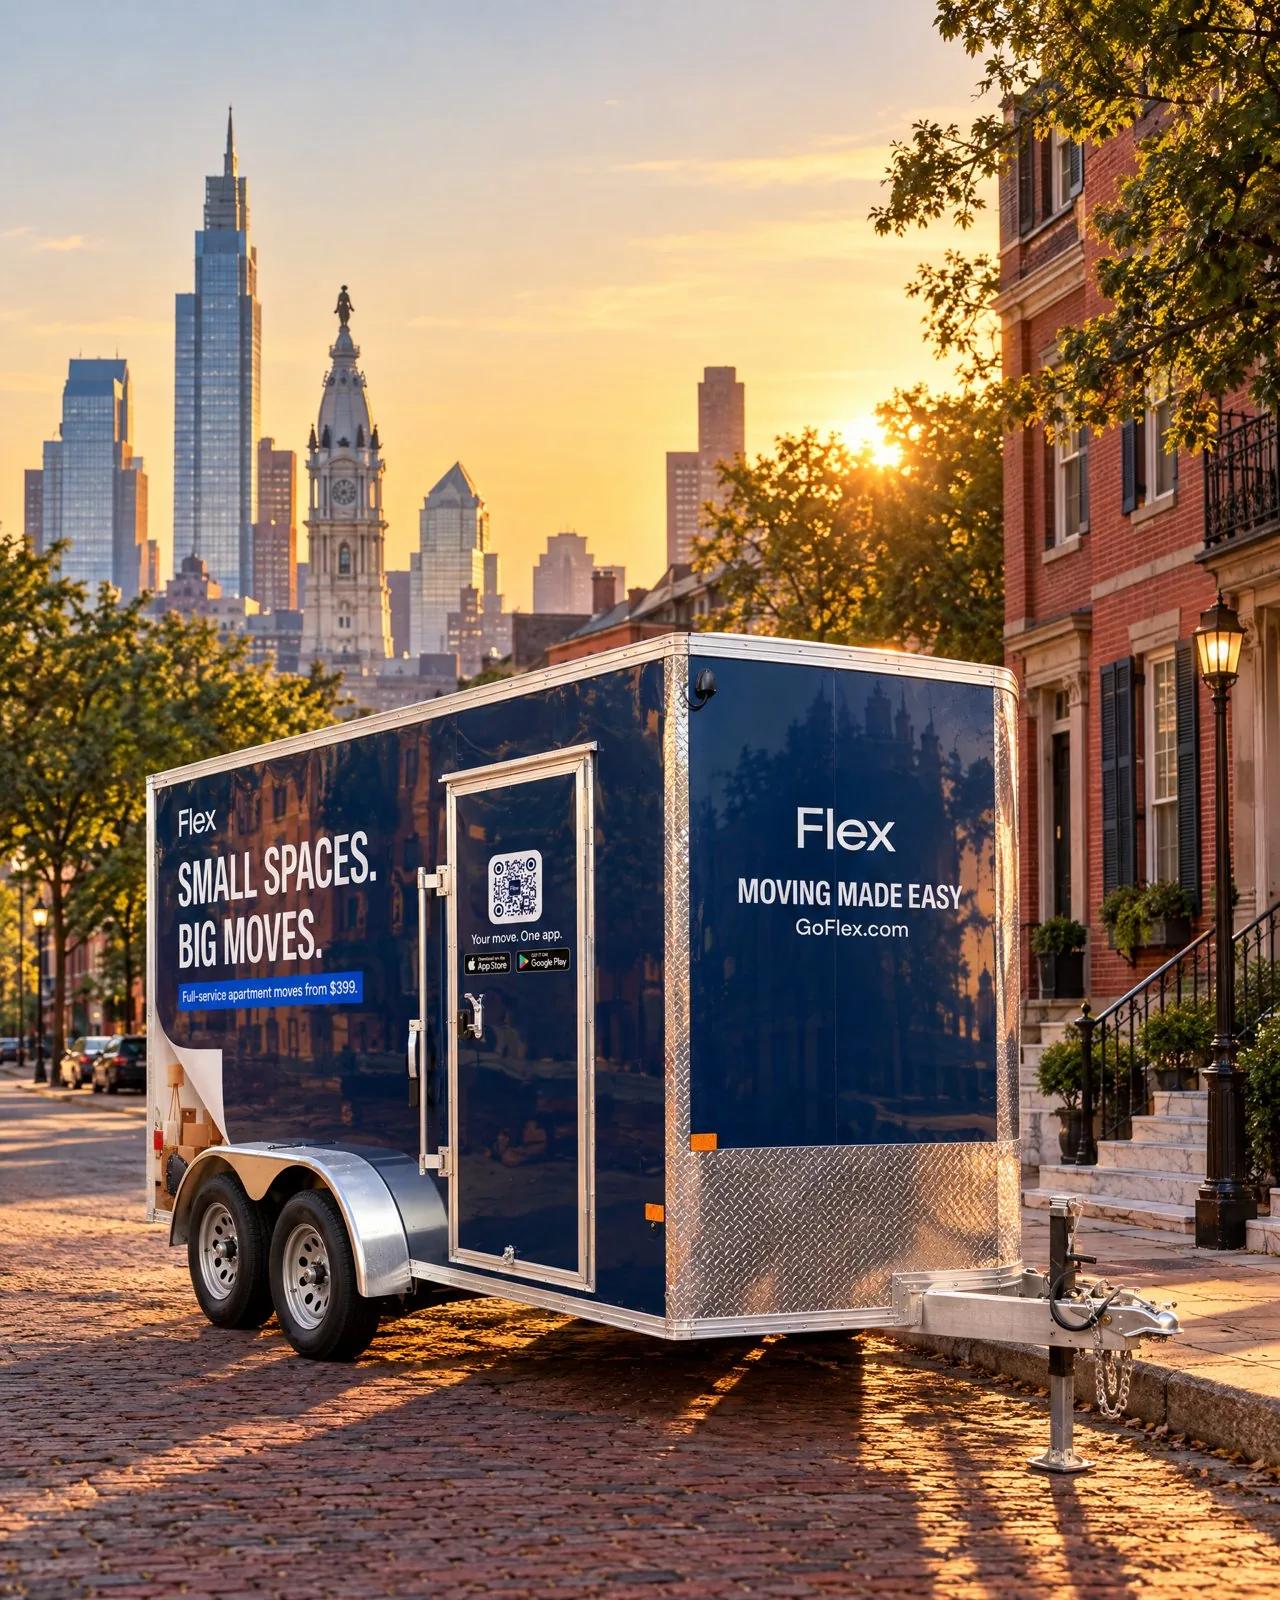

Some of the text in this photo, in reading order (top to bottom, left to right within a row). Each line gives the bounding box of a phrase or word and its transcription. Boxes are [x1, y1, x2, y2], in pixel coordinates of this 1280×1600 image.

[178, 808, 217, 838] Flex
[797, 806, 896, 853] Flex
[178, 830, 377, 908] SMALL SPACES.
[738, 877, 963, 910] MOVING MADE EASY
[179, 908, 322, 969] BIG MOVES.
[471, 930, 563, 945] Your move. One app.
[796, 918, 909, 938] GoFlex.com
[478, 961, 507, 972] App Store
[531, 957, 567, 969] Google Play
[182, 980, 358, 1003] Full-service apartment moves from $399.
